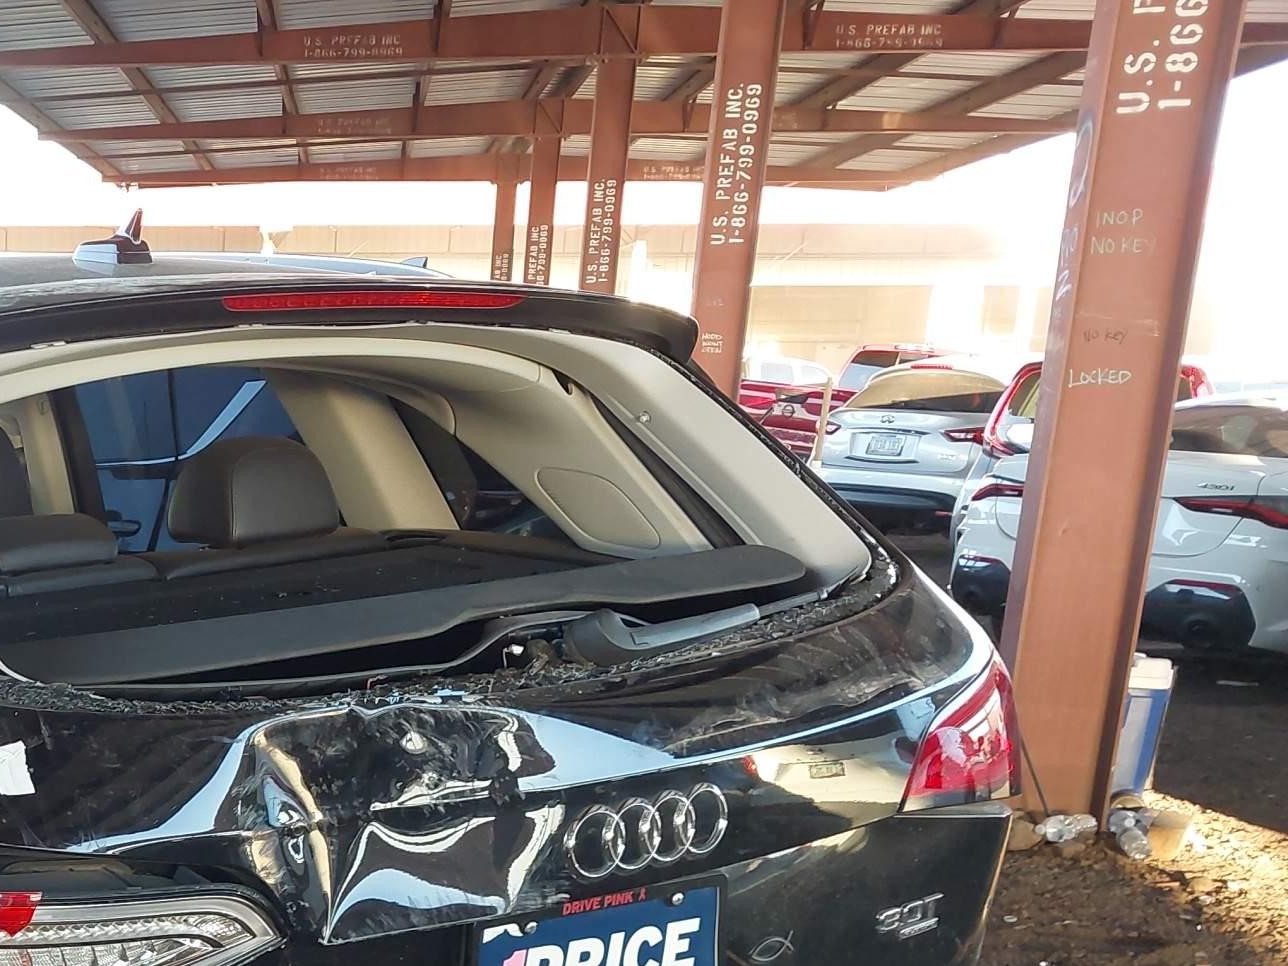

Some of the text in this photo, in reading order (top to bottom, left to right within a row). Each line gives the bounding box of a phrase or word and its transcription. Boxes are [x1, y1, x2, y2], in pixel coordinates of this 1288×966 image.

[1116, 40, 1160, 114] U.S.
[711, 83, 744, 245] U.S. PREFAB INC.
[728, 83, 762, 243] 1-866-799-0969
[588, 207, 603, 255] PREFAB
[1096, 208, 1144, 228] INOP
[1091, 236, 1157, 255] NO KEY
[1068, 368, 1132, 388] LOCKED
[562, 890, 634, 916] DRIVE PINK
